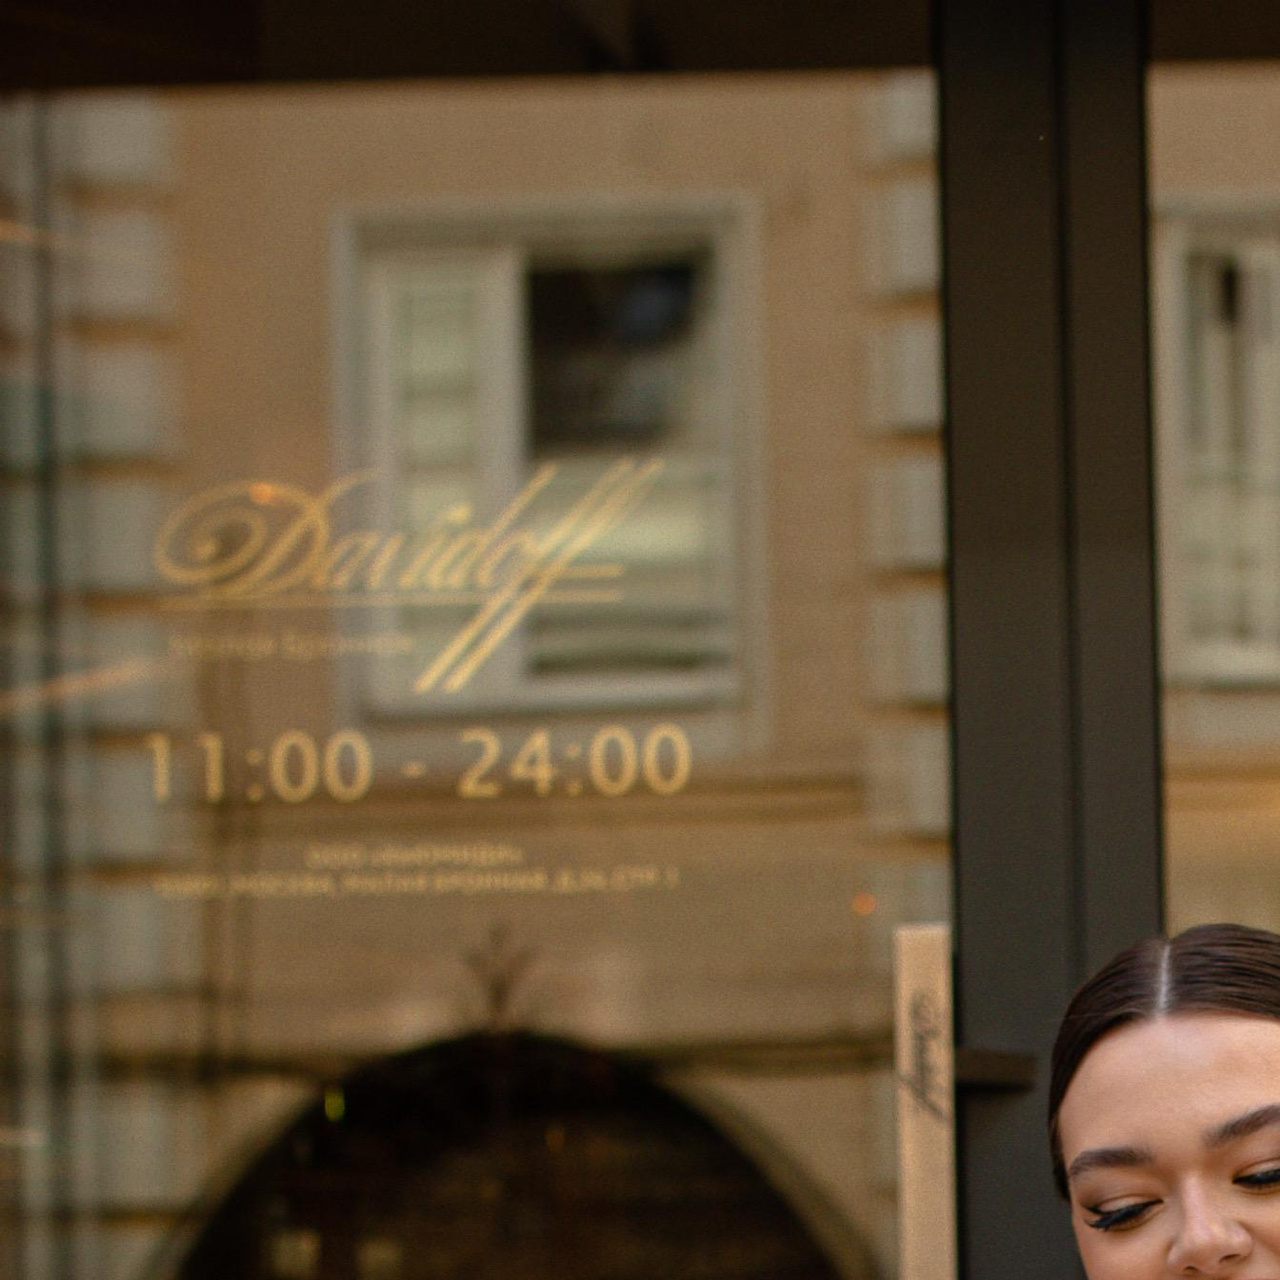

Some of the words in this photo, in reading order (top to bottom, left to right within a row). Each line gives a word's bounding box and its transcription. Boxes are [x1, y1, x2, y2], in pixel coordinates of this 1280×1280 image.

[154, 459, 664, 693] Davidoff
[146, 730, 373, 803] 11:00
[457, 723, 692, 799] 24:00
